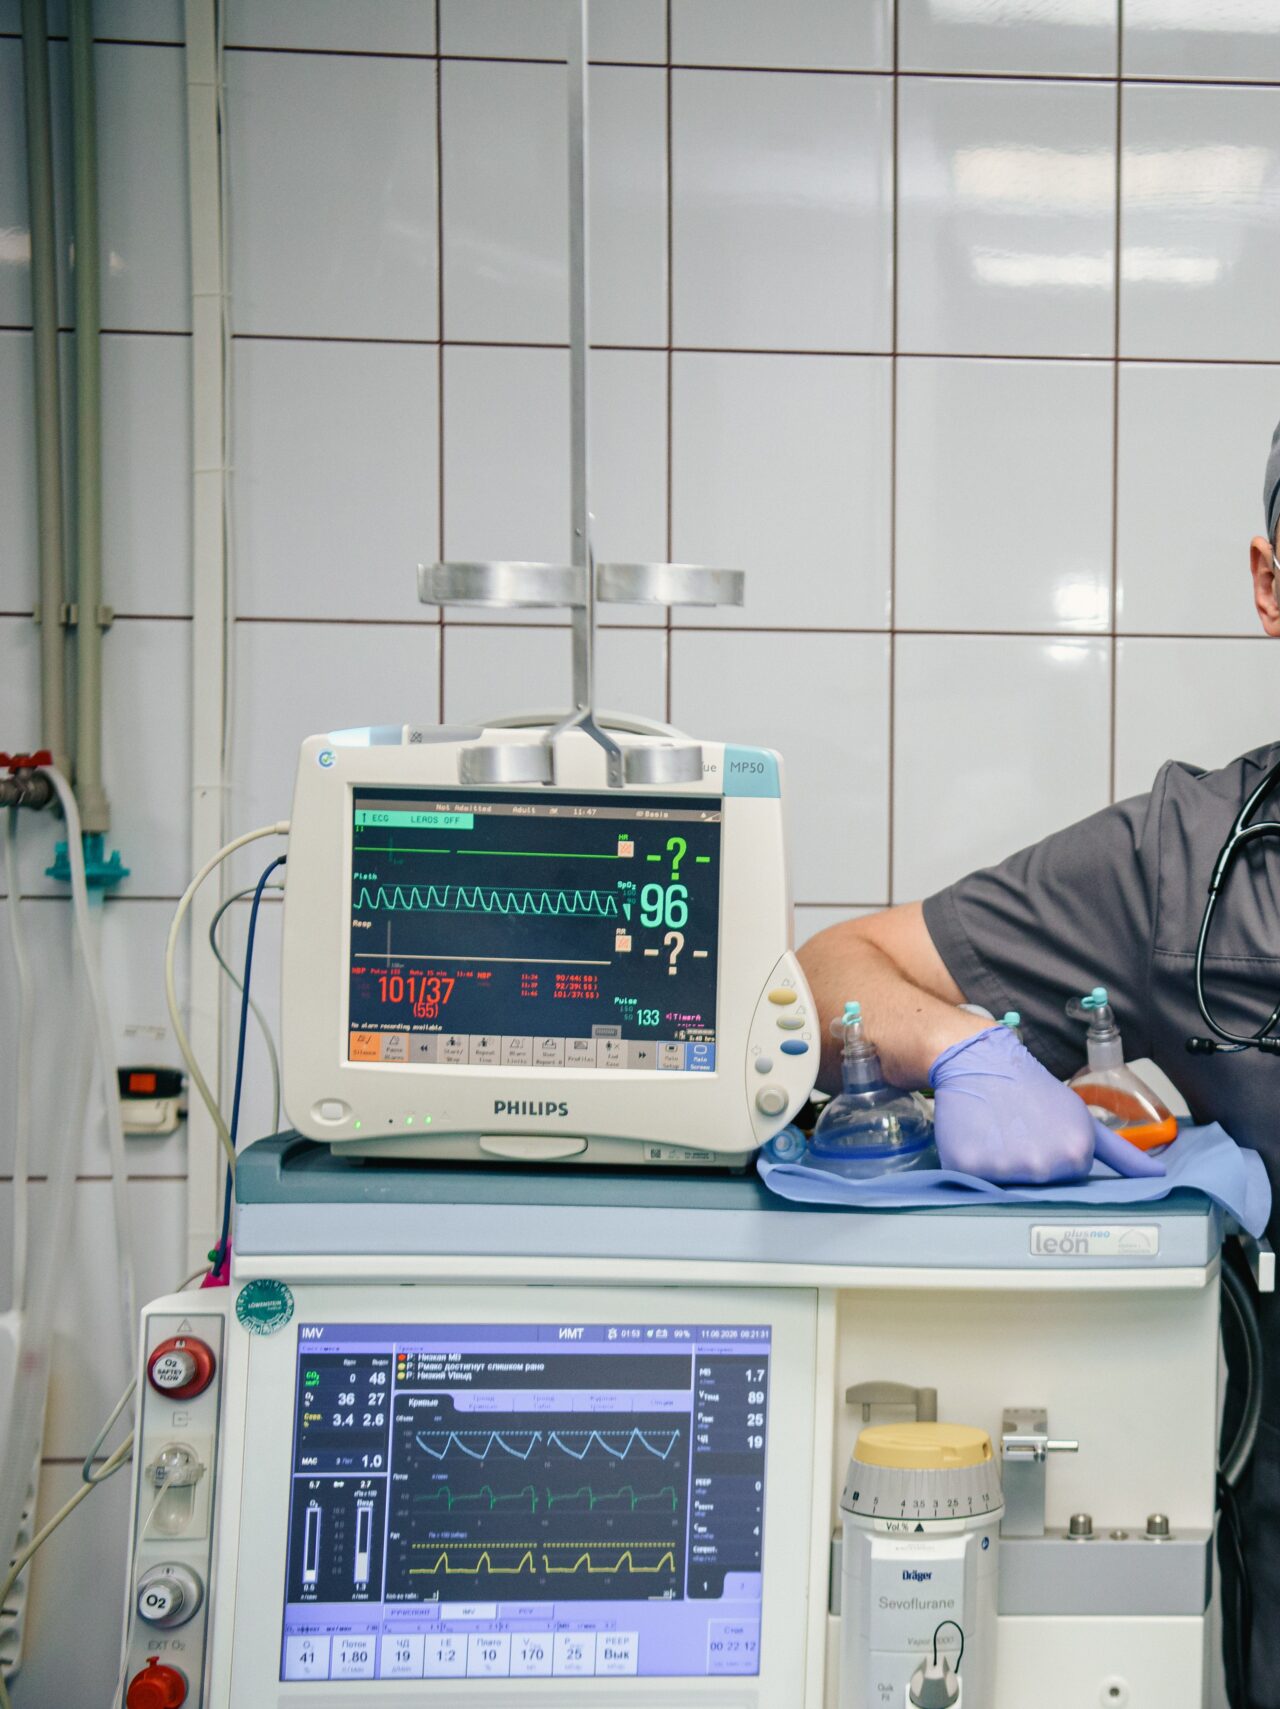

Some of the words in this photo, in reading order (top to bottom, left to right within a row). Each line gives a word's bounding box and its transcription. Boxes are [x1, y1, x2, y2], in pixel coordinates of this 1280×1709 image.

[730, 761, 764, 774] MP50
[436, 804, 450, 812] Not
[454, 805, 492, 813] Admitted
[512, 806, 536, 814] Adult
[573, 808, 596, 816] 11:47
[372, 814, 390, 822] ECG
[410, 815, 439, 824] LEADS
[443, 816, 461, 824] OFF
[353, 872, 378, 880] Pleth
[640, 883, 689, 928] 96
[378, 976, 455, 1004] 101/37
[614, 996, 638, 1005] Pulse
[412, 1002, 438, 1018] (55)
[636, 1009, 660, 1026] 133
[380, 1024, 410, 1032] recording
[412, 1024, 443, 1032] available
[494, 1100, 569, 1116] PHILIPS
[302, 1327, 324, 1338] IMV
[558, 1328, 584, 1340] ИМТ
[164, 1359, 178, 1368] O2
[444, 1364, 485, 1372] достигнут
[525, 1364, 544, 1372] рано
[350, 1373, 356, 1384] 0
[369, 1372, 386, 1385] 48
[745, 1369, 766, 1382] 1.7
[338, 1392, 355, 1406] 36
[368, 1392, 386, 1406] 27
[408, 1398, 438, 1408] Кривые
[748, 1391, 764, 1404] 89
[332, 1413, 354, 1426] 3.4
[362, 1413, 384, 1426] 2.6
[746, 1413, 764, 1426] 25
[747, 1435, 763, 1448] 19
[362, 1454, 382, 1468] 1.0
[754, 1480, 762, 1492] 0
[900, 1500, 906, 1508] 4
[913, 1500, 926, 1508] 3.5
[933, 1500, 939, 1508] 3
[948, 1498, 959, 1507] 2.5
[752, 1526, 760, 1536] 4
[902, 1570, 932, 1582] Dräger
[146, 1594, 166, 1609] O2
[878, 1596, 955, 1610] Sevoflurane
[148, 1640, 168, 1650] EXT
[300, 1652, 315, 1664] 41
[340, 1652, 368, 1662] 1.80
[396, 1650, 410, 1662] 19
[437, 1650, 456, 1662] 1:2
[482, 1650, 497, 1662] 10
[522, 1650, 544, 1661] 170
[566, 1650, 582, 1660] 25
[604, 1649, 630, 1660] Вык
